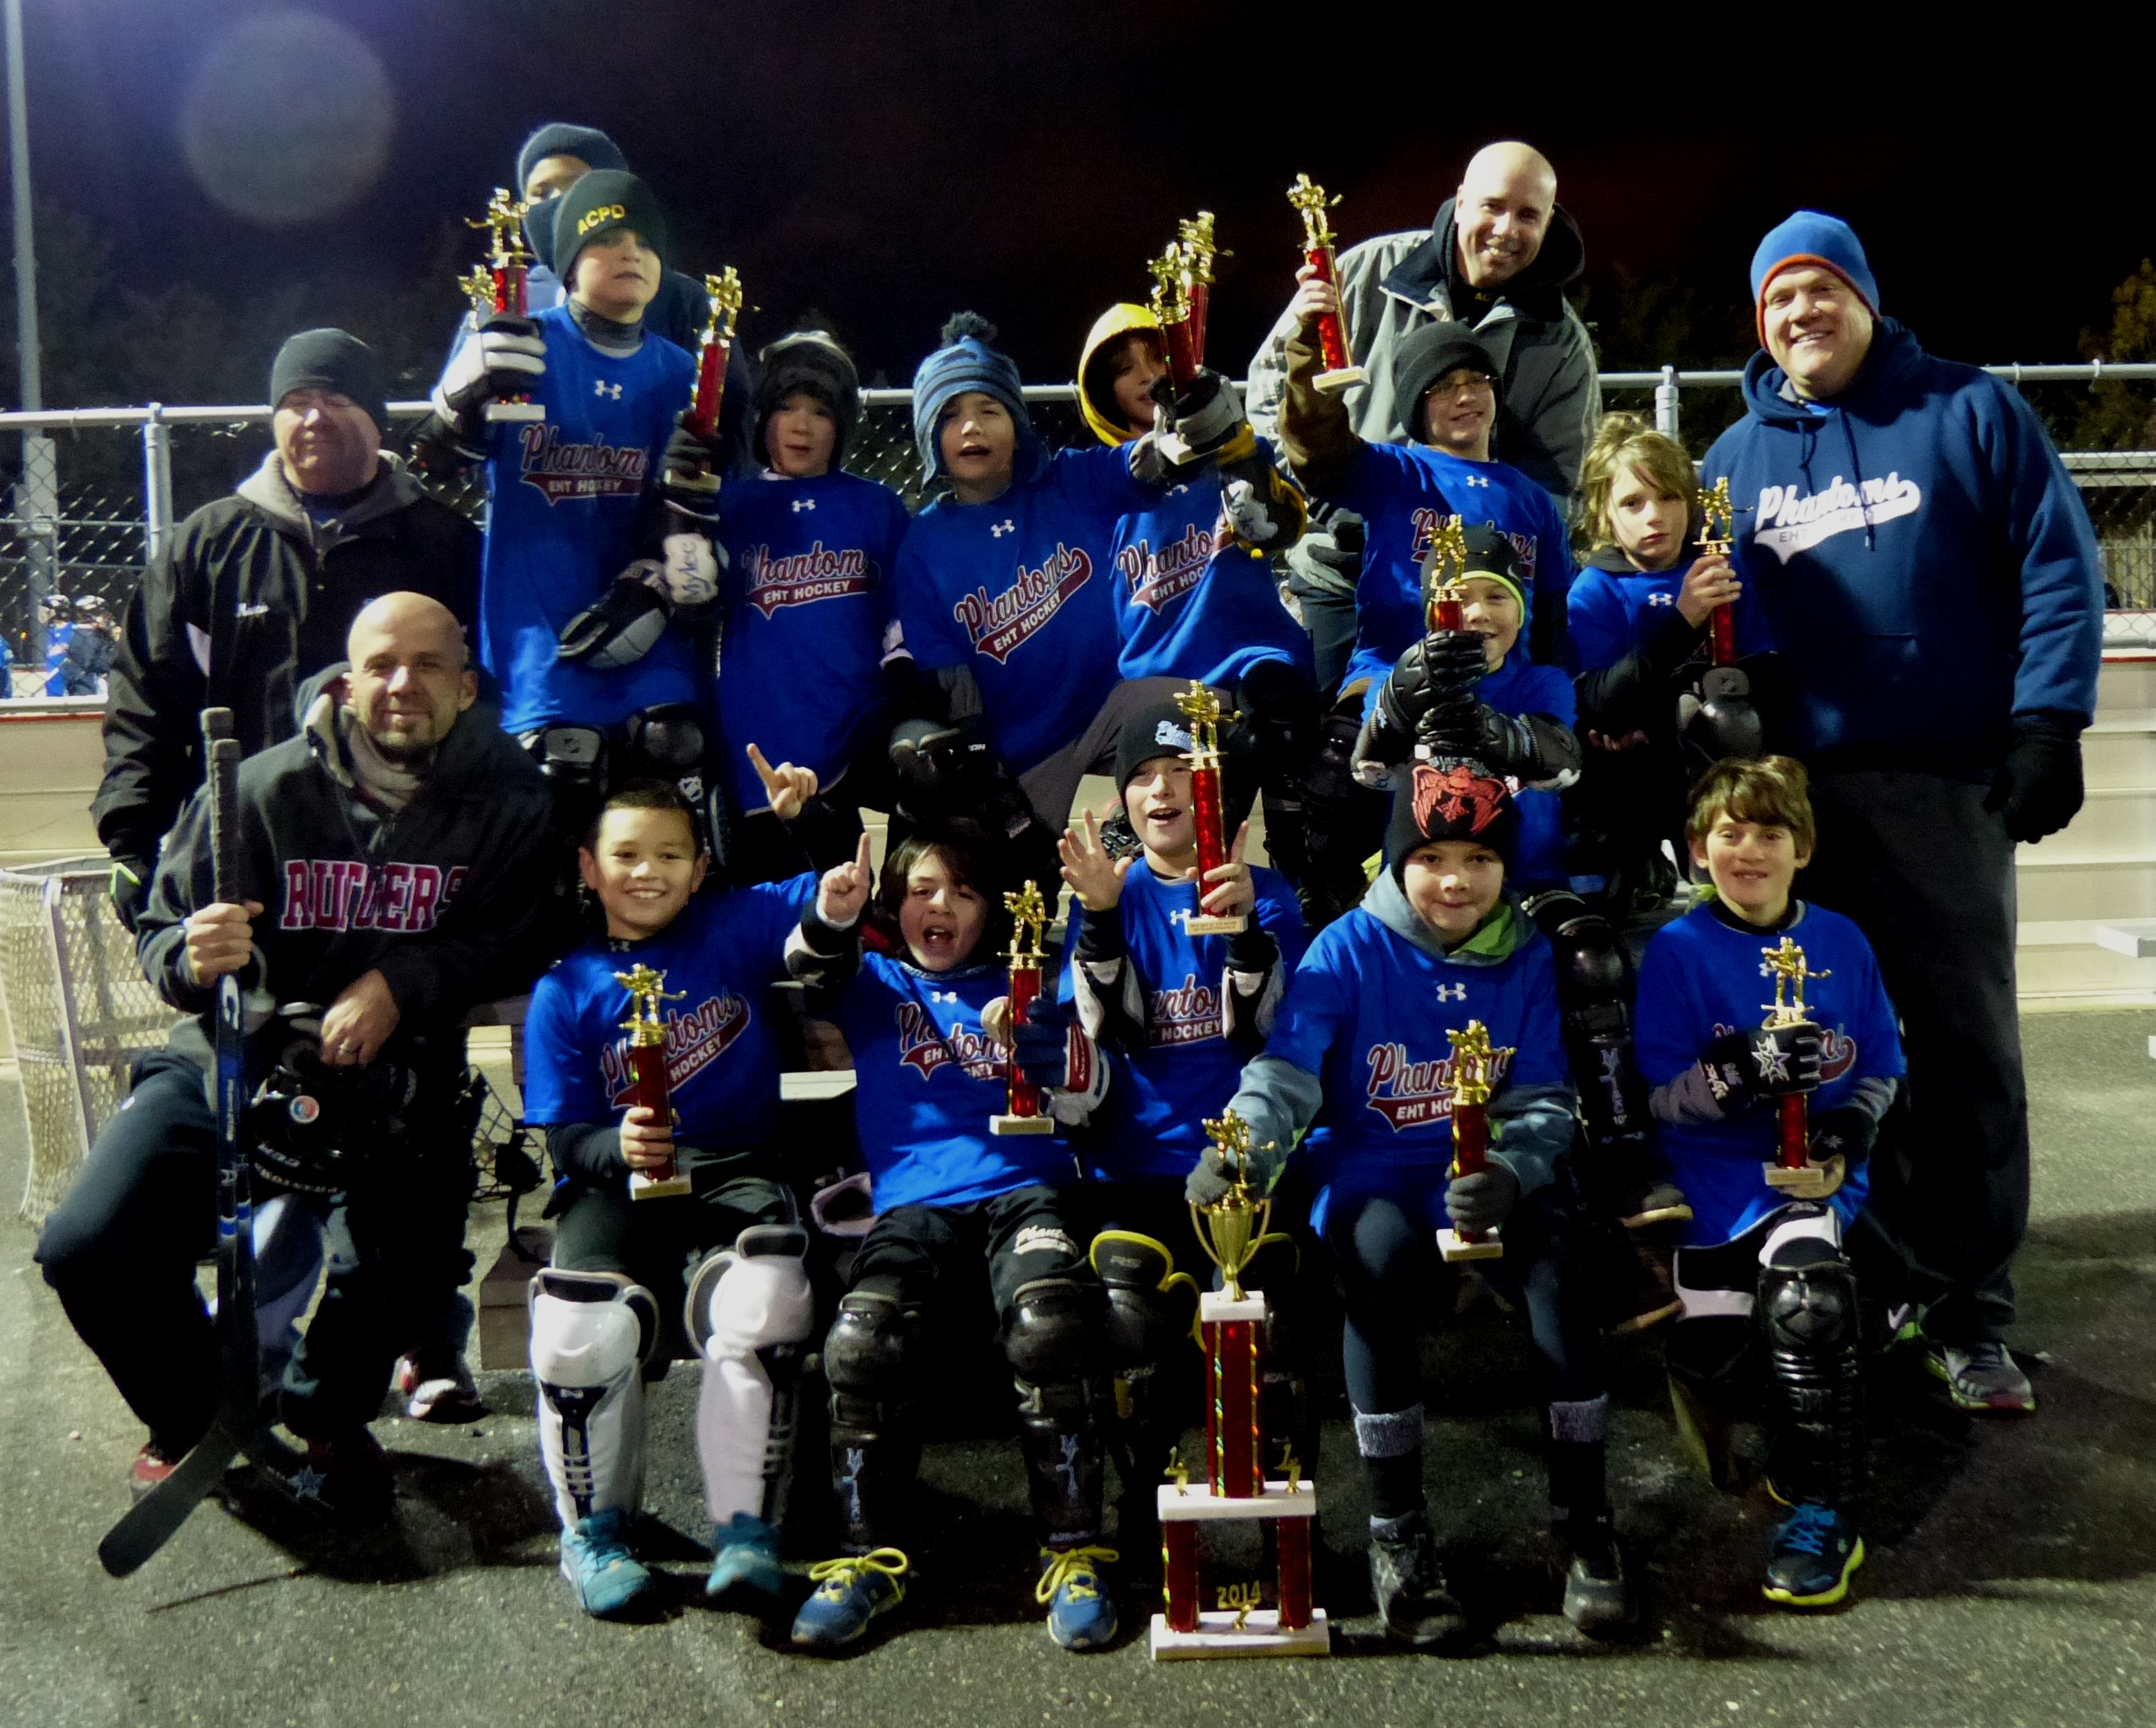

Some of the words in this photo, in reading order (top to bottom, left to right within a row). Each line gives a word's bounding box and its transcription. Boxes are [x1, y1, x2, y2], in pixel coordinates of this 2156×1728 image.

[519, 423, 650, 474] Phantom
[763, 590, 789, 605] EHT
[794, 580, 851, 600] HOCKEY
[954, 542, 1073, 644] Phantoms
[1151, 580, 1176, 601] EHT
[1179, 564, 1206, 589] HOC
[992, 627, 1019, 652] EHT
[1020, 589, 1062, 634] HOCKEY
[1161, 1019, 1222, 1042] HOCKEY
[670, 1035, 722, 1082] HOCKEY
[1396, 1103, 1426, 1120] EHT
[1216, 1580, 1261, 1609] 2014
